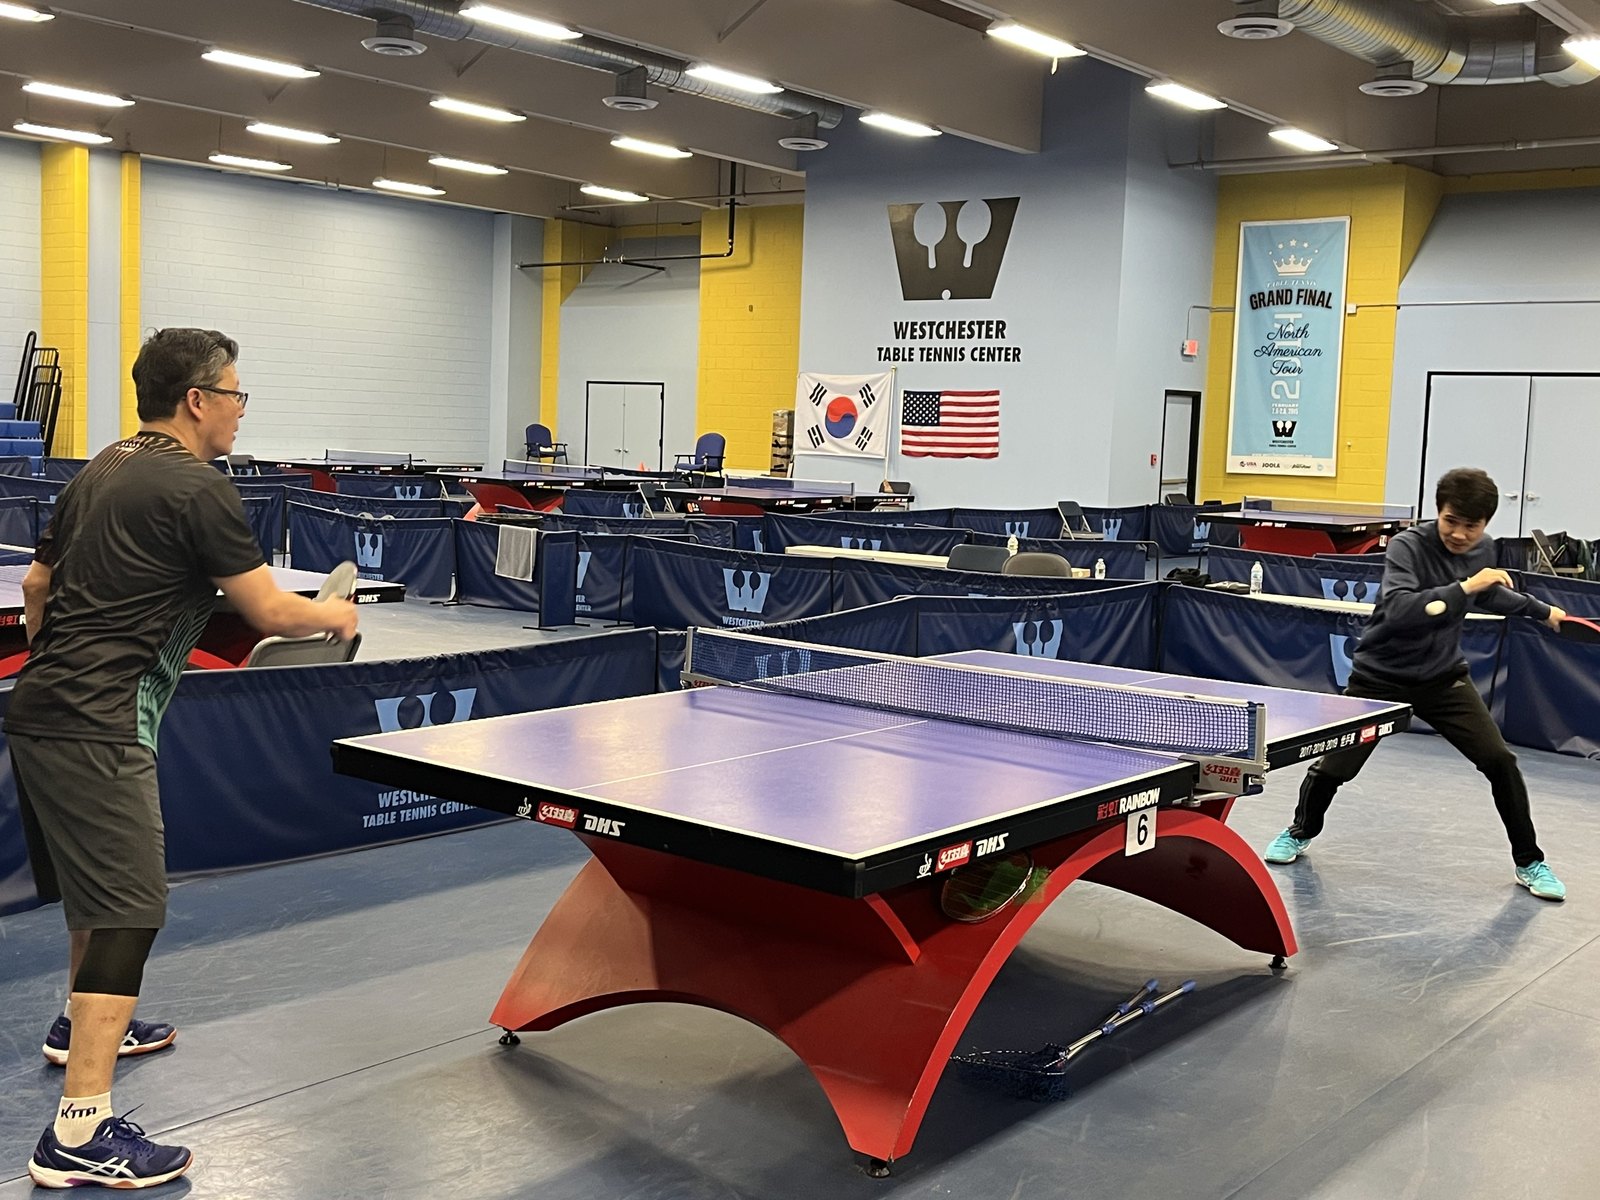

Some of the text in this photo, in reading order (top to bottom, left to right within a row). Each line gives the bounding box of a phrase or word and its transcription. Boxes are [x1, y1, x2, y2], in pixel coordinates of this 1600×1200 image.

[1250, 289, 1332, 310] GRAND FINAL
[894, 320, 1007, 339] WESTCHESTER
[1267, 323, 1310, 341] North
[877, 347, 1021, 362] TABLE TENNIS CENTER
[1253, 342, 1323, 358] American
[1270, 359, 1304, 376] Tour
[357, 594, 381, 603] DHS
[1119, 787, 1161, 815] RAINBOW
[363, 811, 397, 828] TABLE
[400, 804, 437, 823] TENNIS
[583, 813, 626, 837] DHS
[1137, 813, 1149, 846] 6
[976, 832, 1009, 857] DHS
